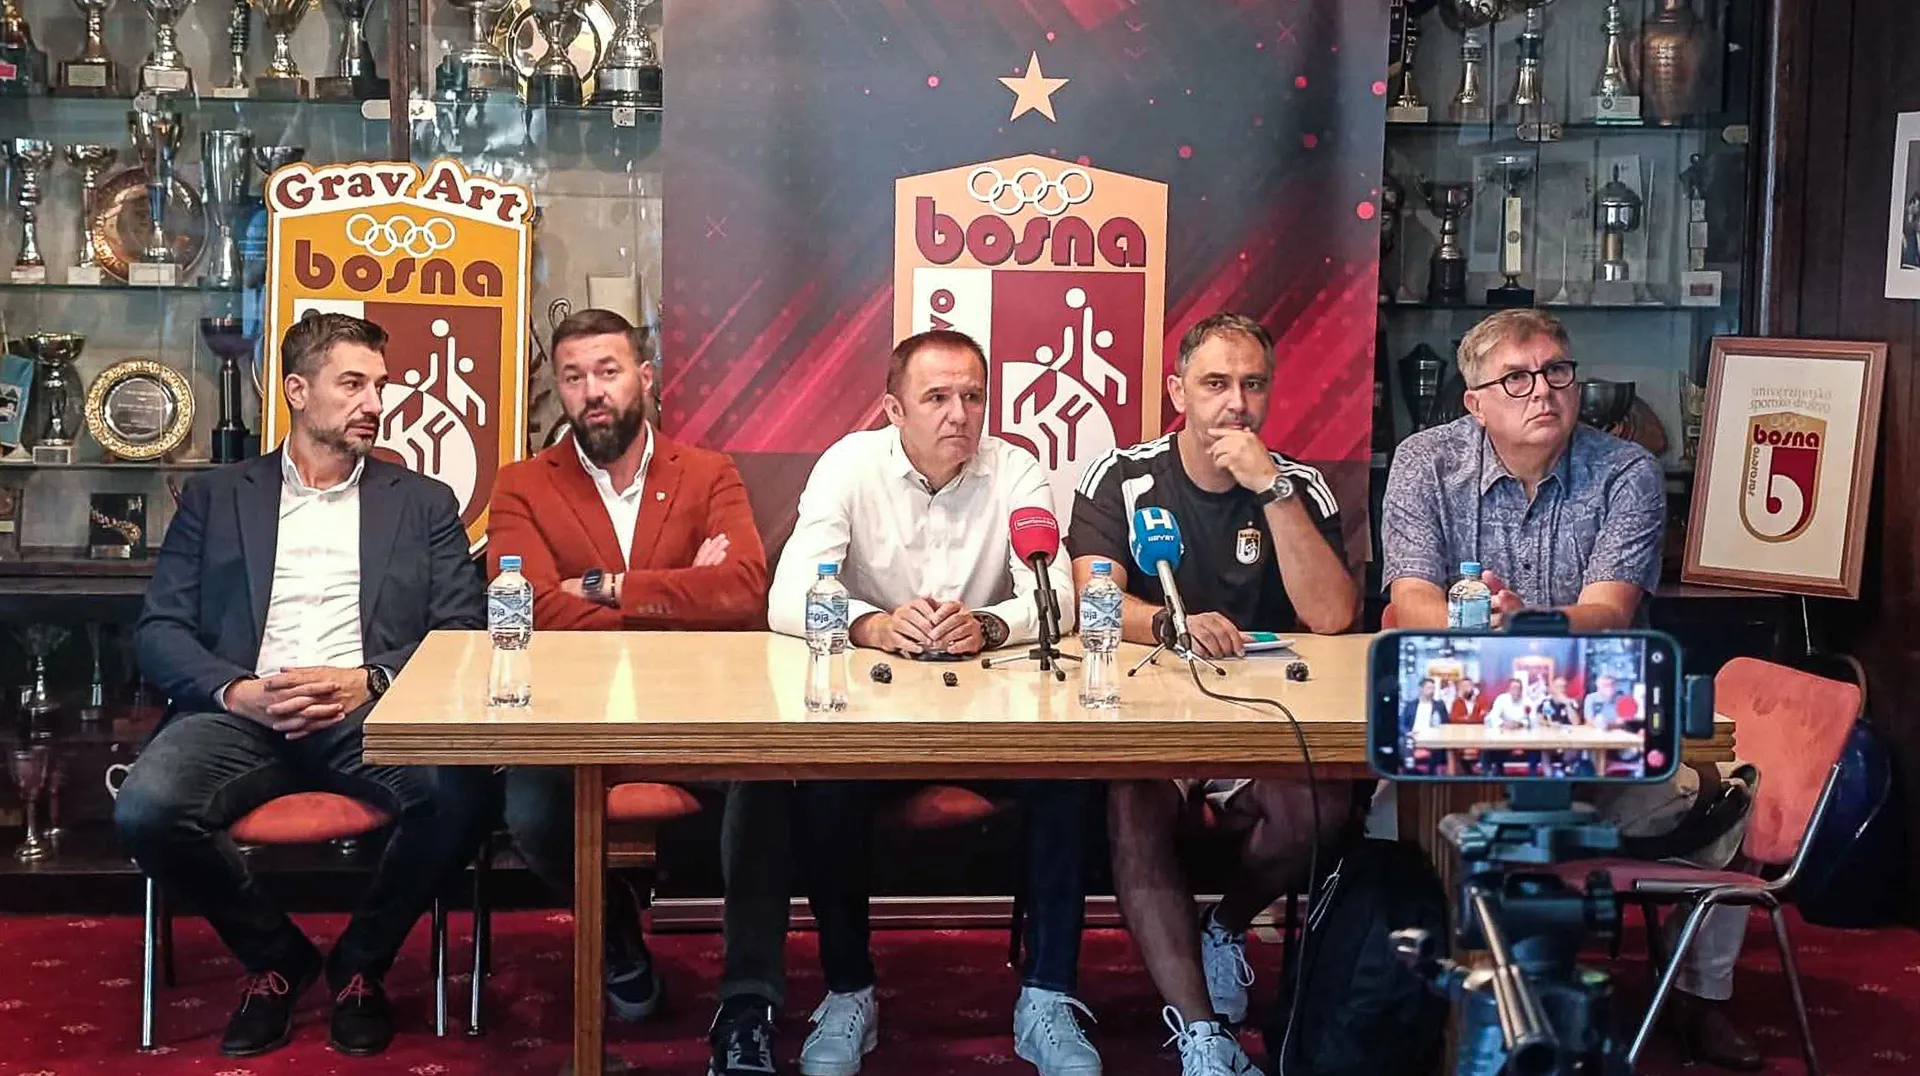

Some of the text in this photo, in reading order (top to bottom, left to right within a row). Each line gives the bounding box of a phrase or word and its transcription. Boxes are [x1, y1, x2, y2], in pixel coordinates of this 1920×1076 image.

[276, 168, 522, 222] Grav Art
[916, 196, 1147, 267] bosna
[295, 239, 503, 297] bosna
[1753, 424, 1820, 448] bosna
[1748, 447, 1760, 496] sarajevo
[1142, 509, 1173, 531] H
